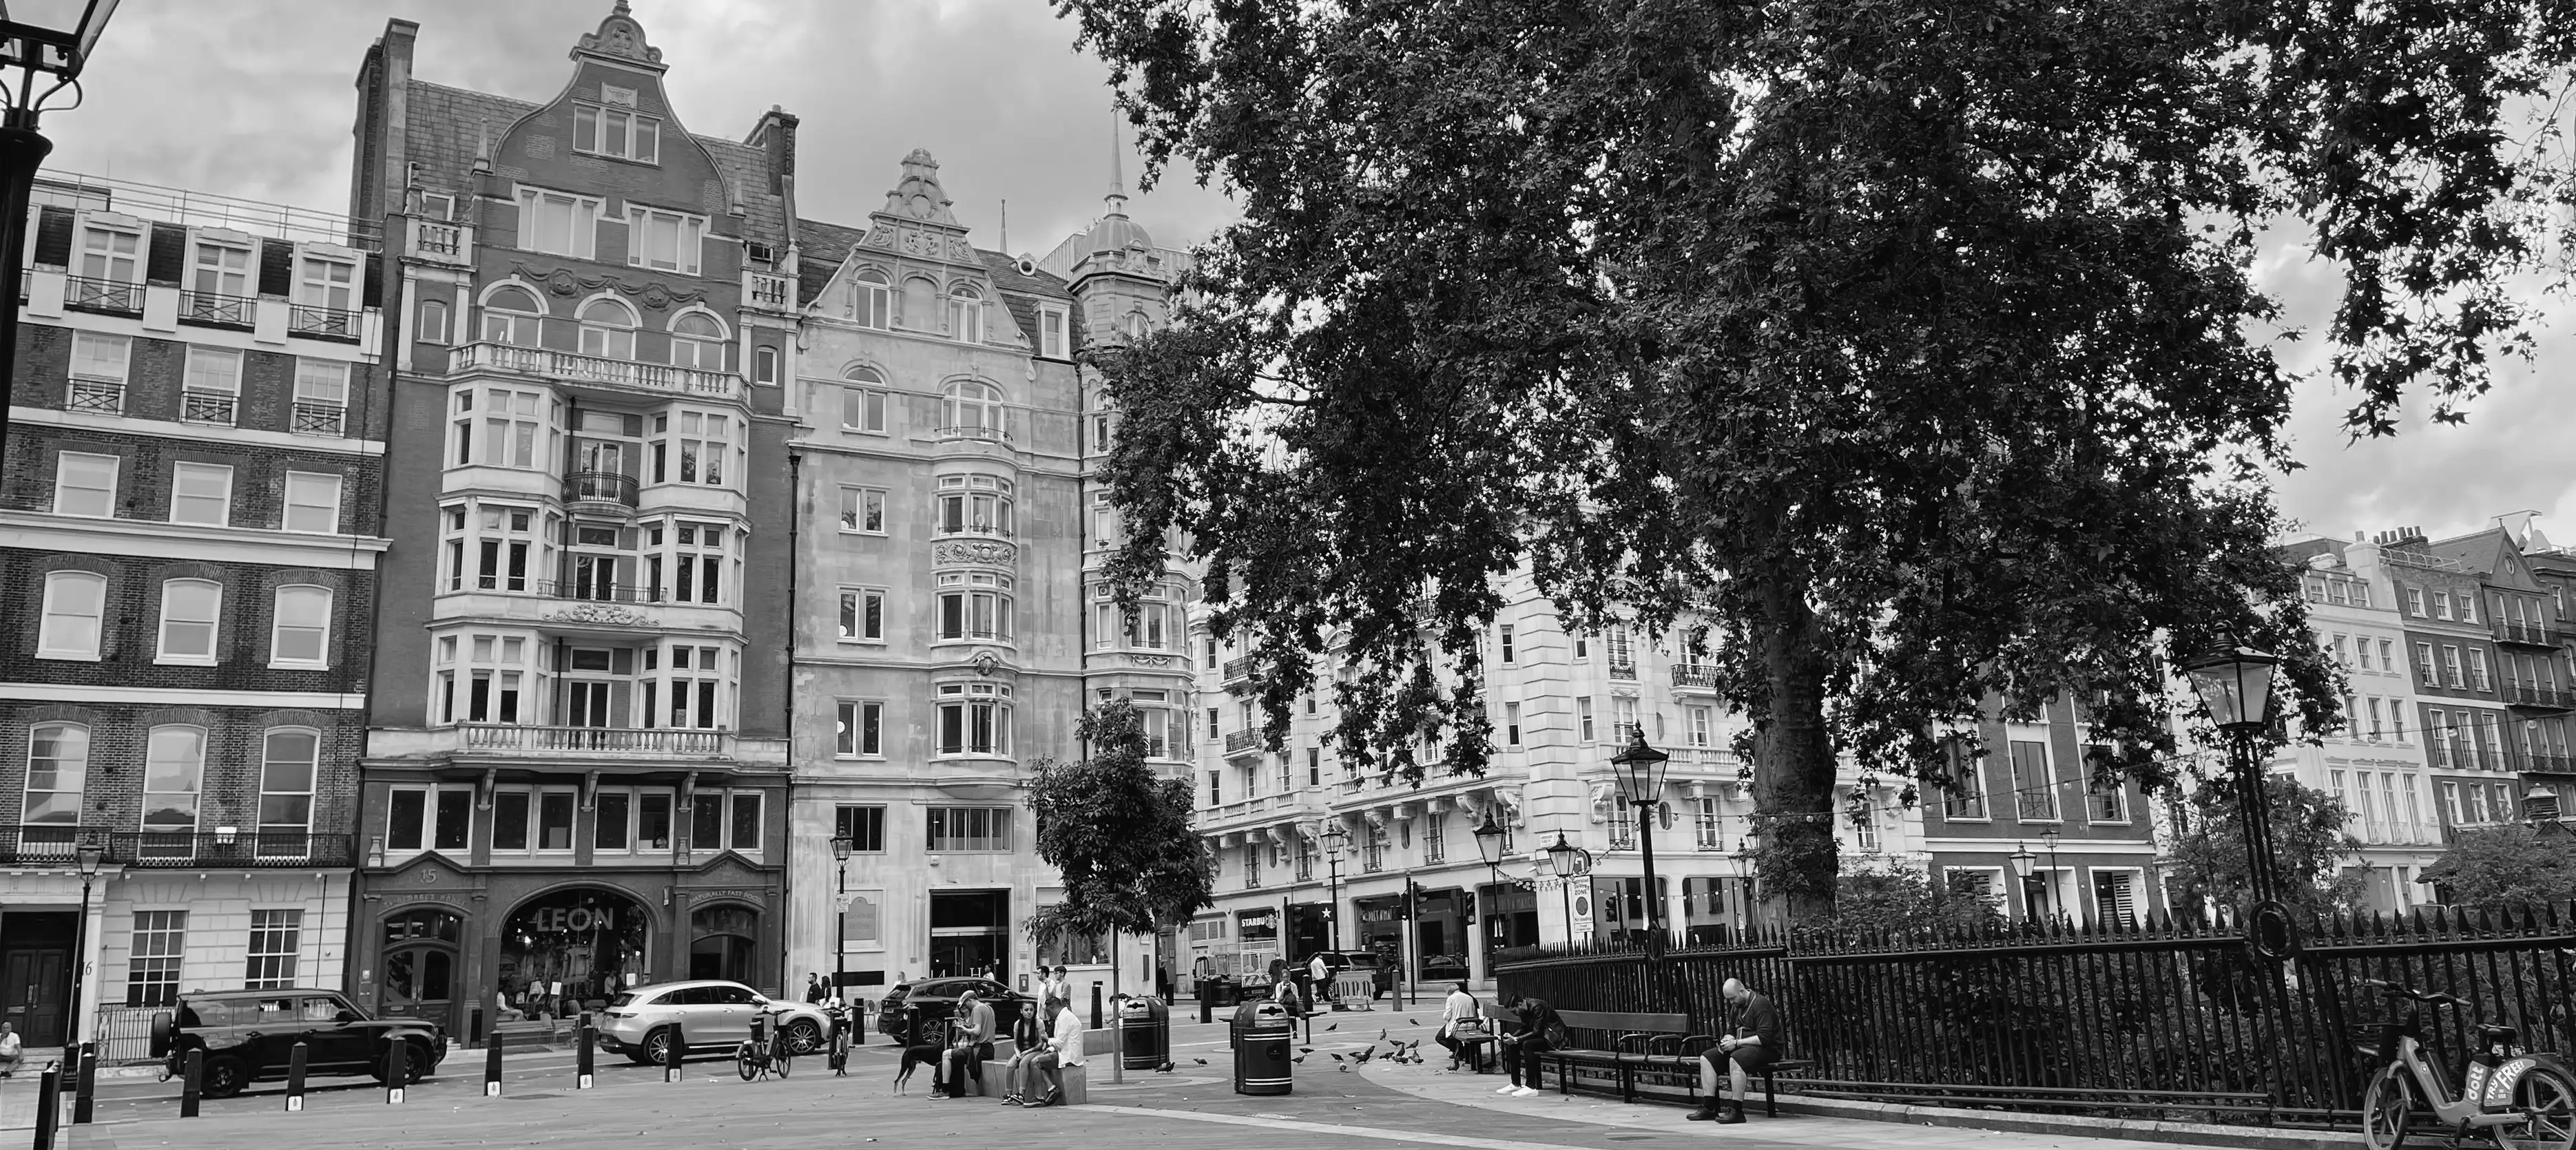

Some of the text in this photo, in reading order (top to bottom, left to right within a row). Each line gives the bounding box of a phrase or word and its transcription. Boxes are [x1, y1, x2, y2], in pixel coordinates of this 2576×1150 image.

[420, 868, 437, 884] 15
[689, 890, 725, 906] NATURALLY
[744, 892, 762, 903] FOOD
[537, 908, 613, 932] LEON
[2468, 1066, 2484, 1101] dott
[2486, 1060, 2525, 1100] TRY FREE!
